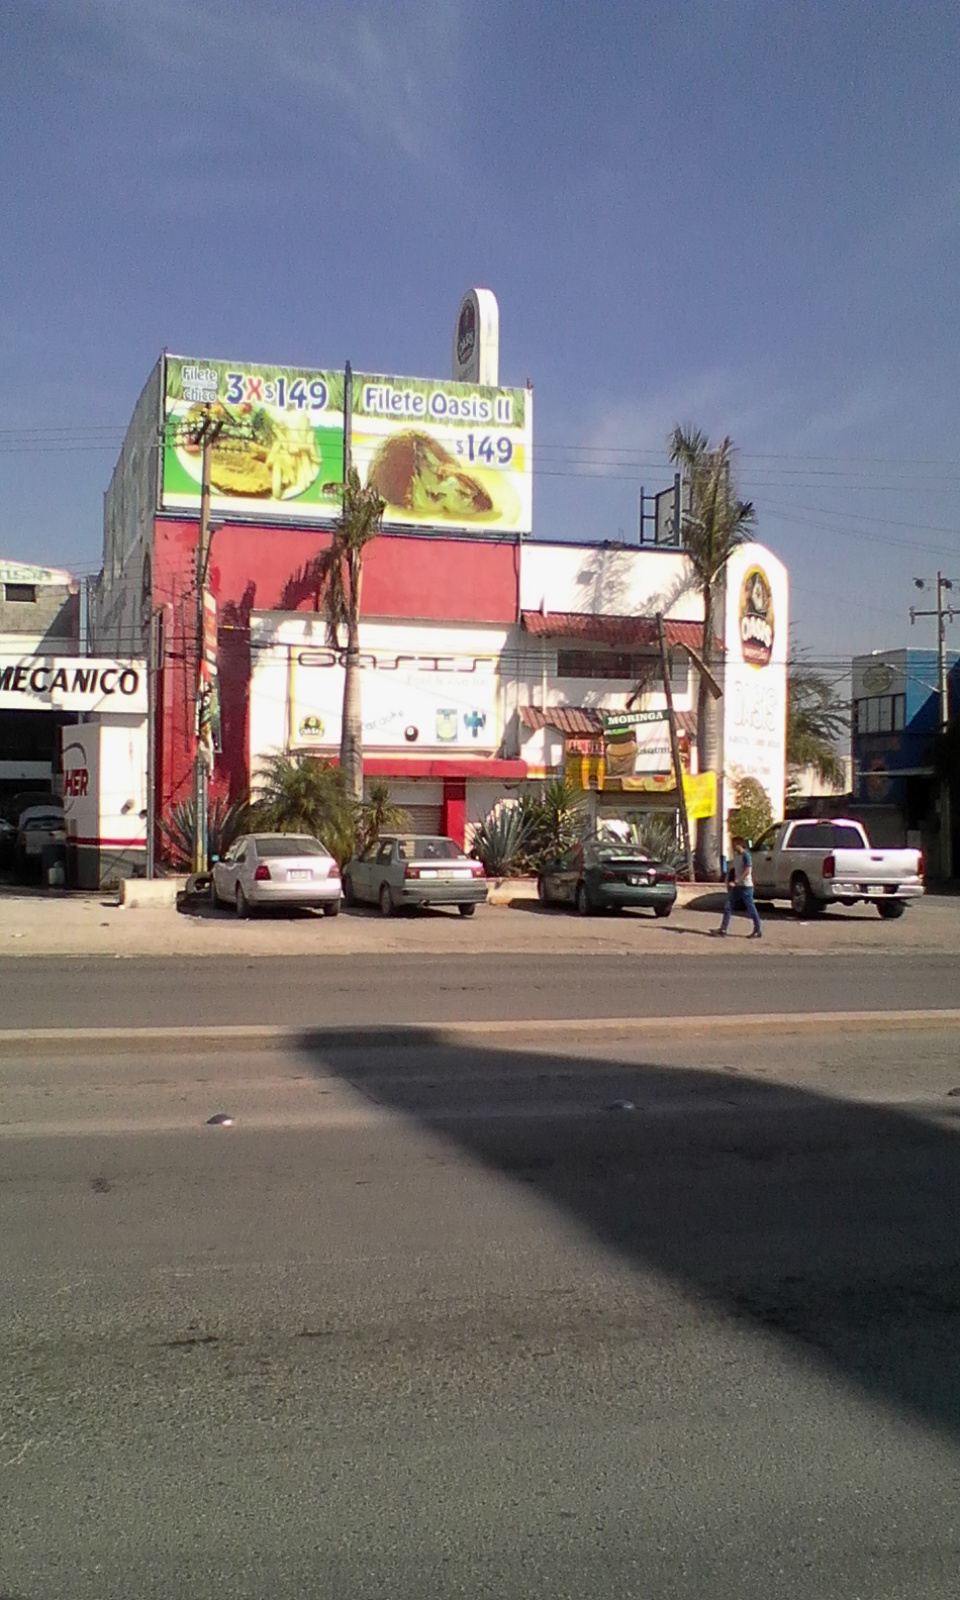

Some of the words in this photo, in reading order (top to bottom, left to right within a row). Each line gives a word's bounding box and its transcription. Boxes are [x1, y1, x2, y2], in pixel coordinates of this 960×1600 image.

[183, 366, 217, 382] Filete
[184, 387, 217, 402] chico
[366, 387, 424, 412] Filete
[431, 392, 489, 418] Oasis
[455, 433, 514, 464] $149
[741, 615, 772, 648] OASIS
[607, 711, 664, 726] MORINGA
